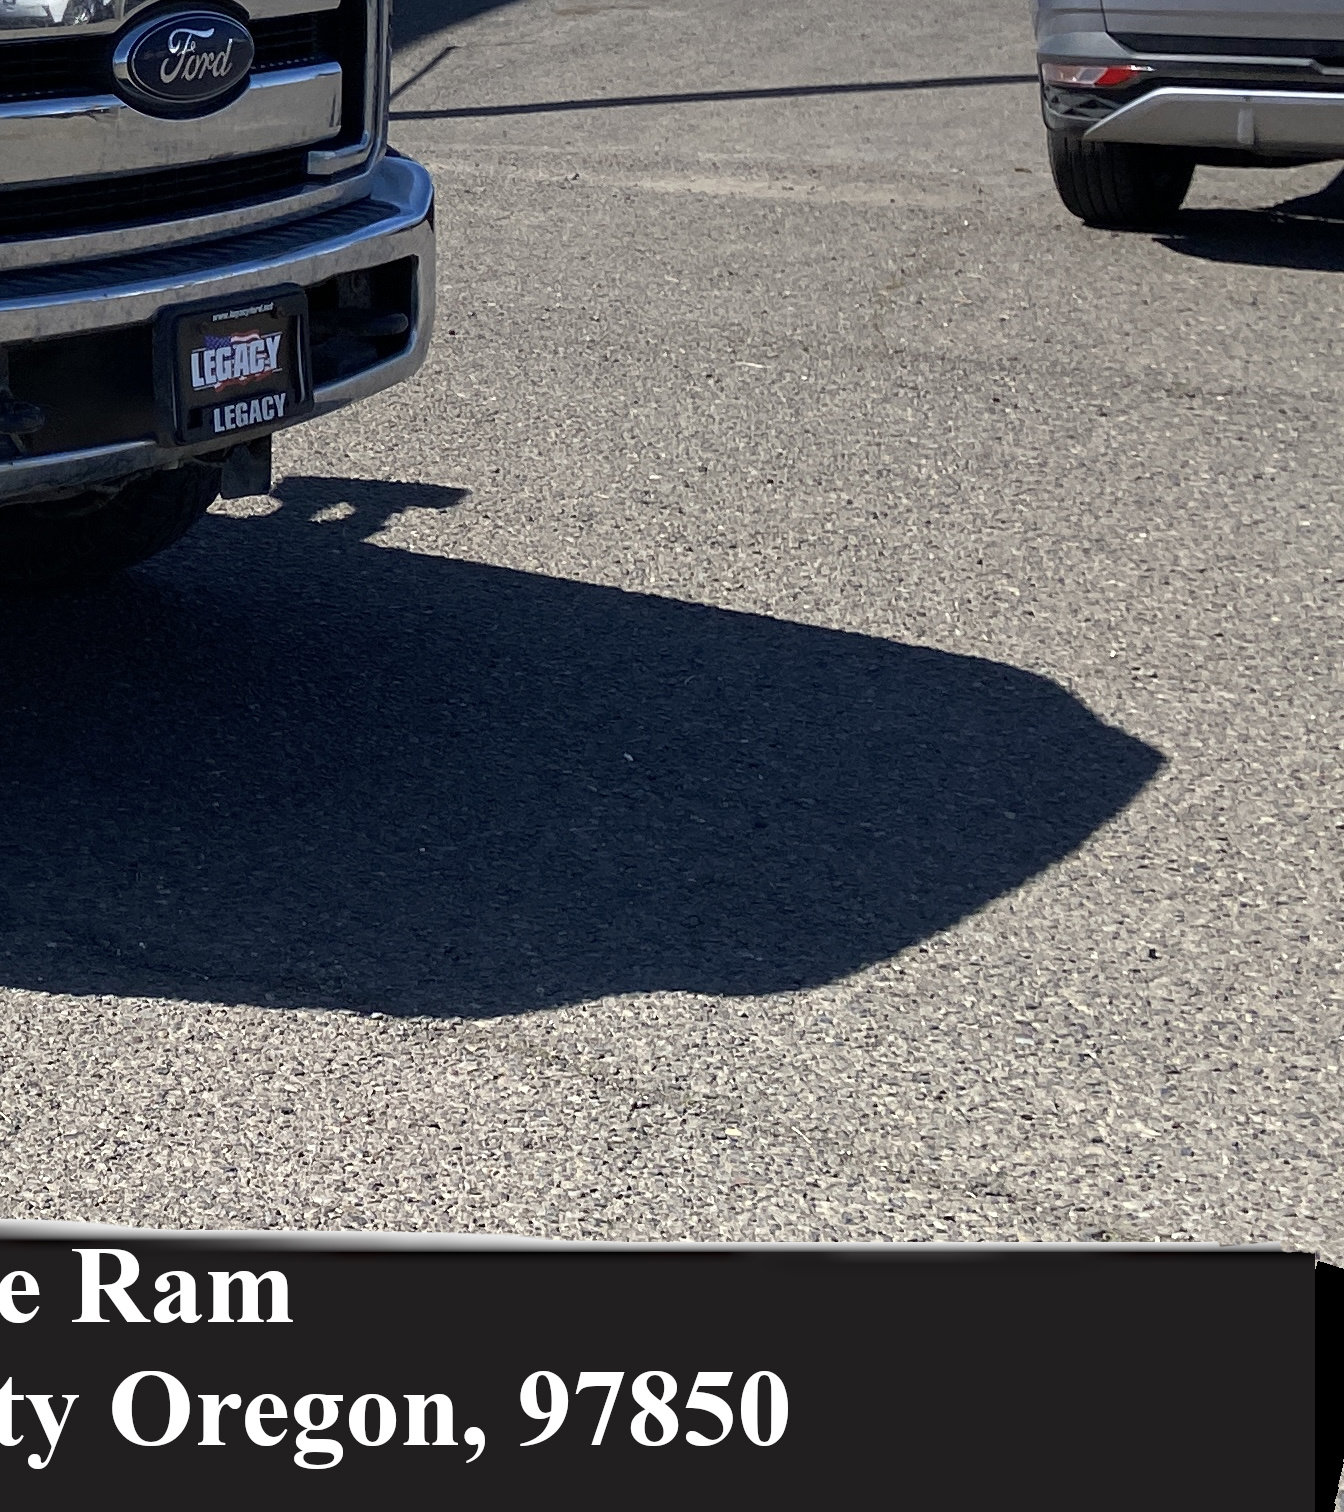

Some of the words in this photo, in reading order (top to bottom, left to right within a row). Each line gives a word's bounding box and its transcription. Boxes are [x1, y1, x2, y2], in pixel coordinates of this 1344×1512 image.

[160, 28, 233, 84] Ford
[191, 334, 281, 388] LEGACY
[213, 392, 286, 433] LEGACY
